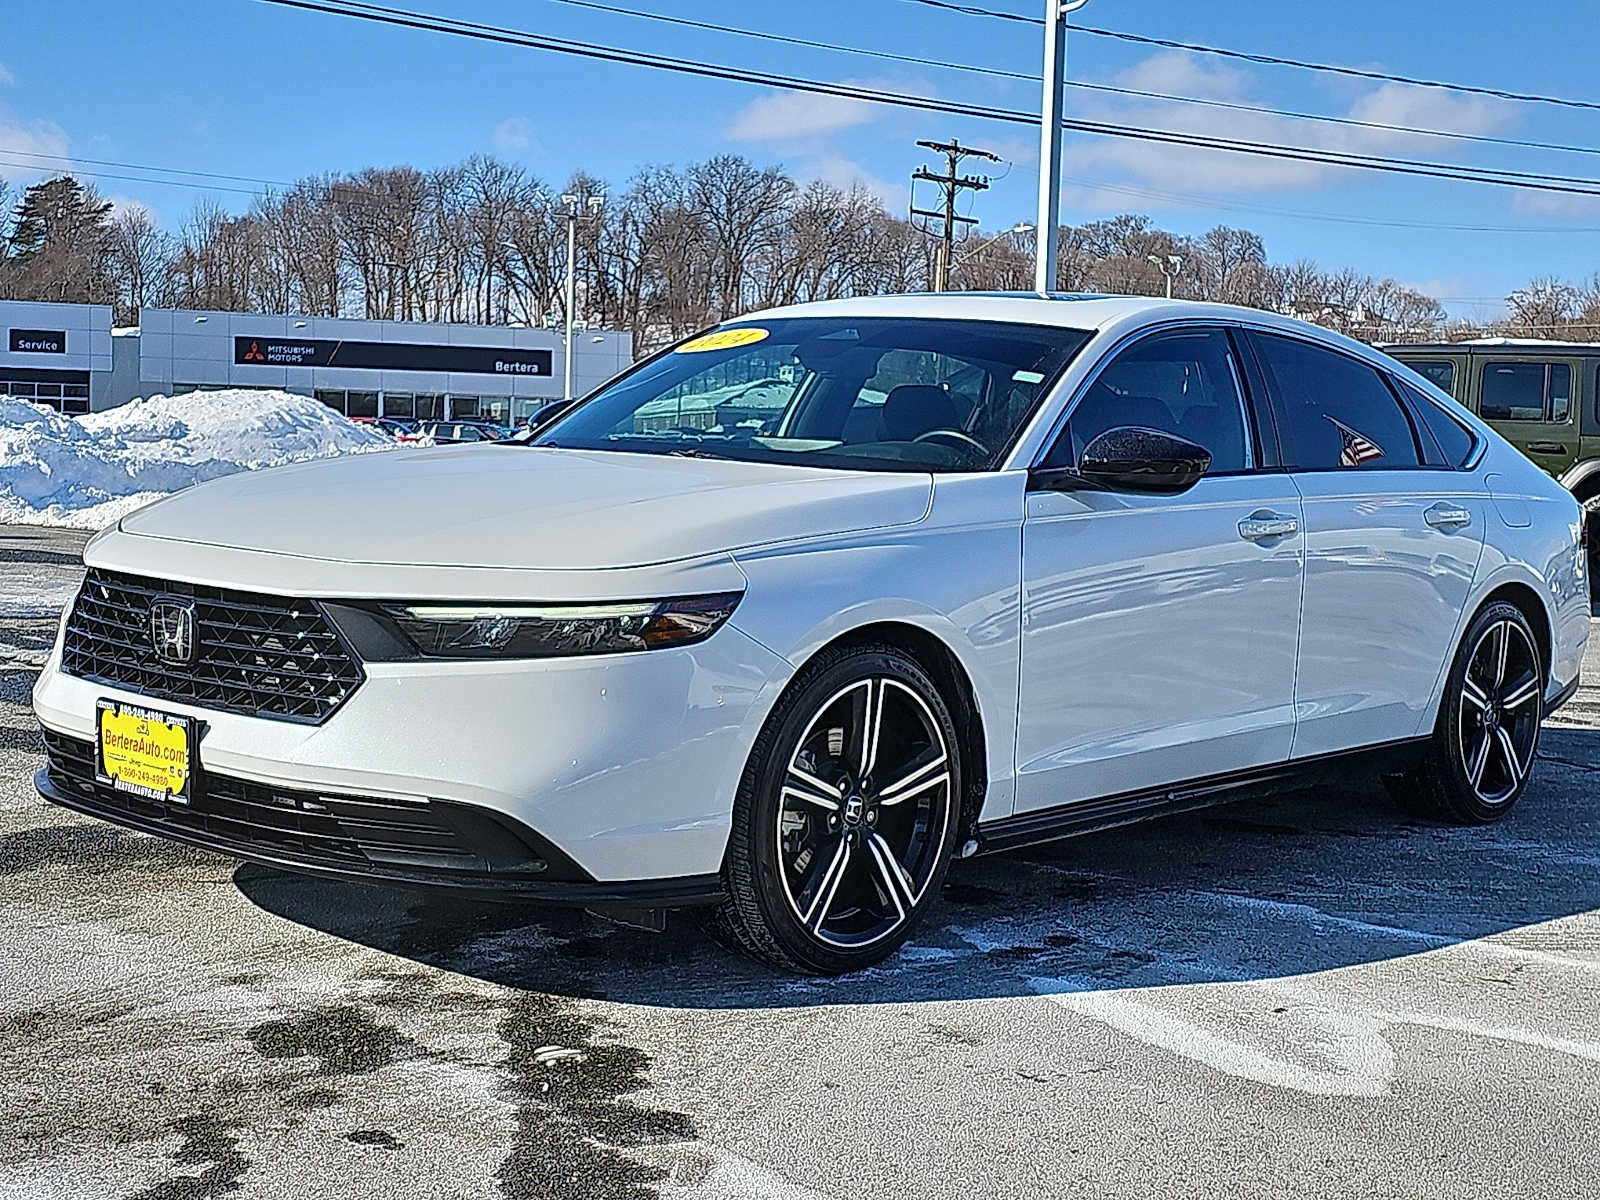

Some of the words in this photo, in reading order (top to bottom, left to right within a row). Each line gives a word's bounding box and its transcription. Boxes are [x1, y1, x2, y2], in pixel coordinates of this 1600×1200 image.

[267, 345, 315, 355] MITSUBISHI
[267, 353, 303, 362] MOTORS
[495, 361, 538, 373] Bertera
[104, 728, 185, 764] BerteraAuto.com
